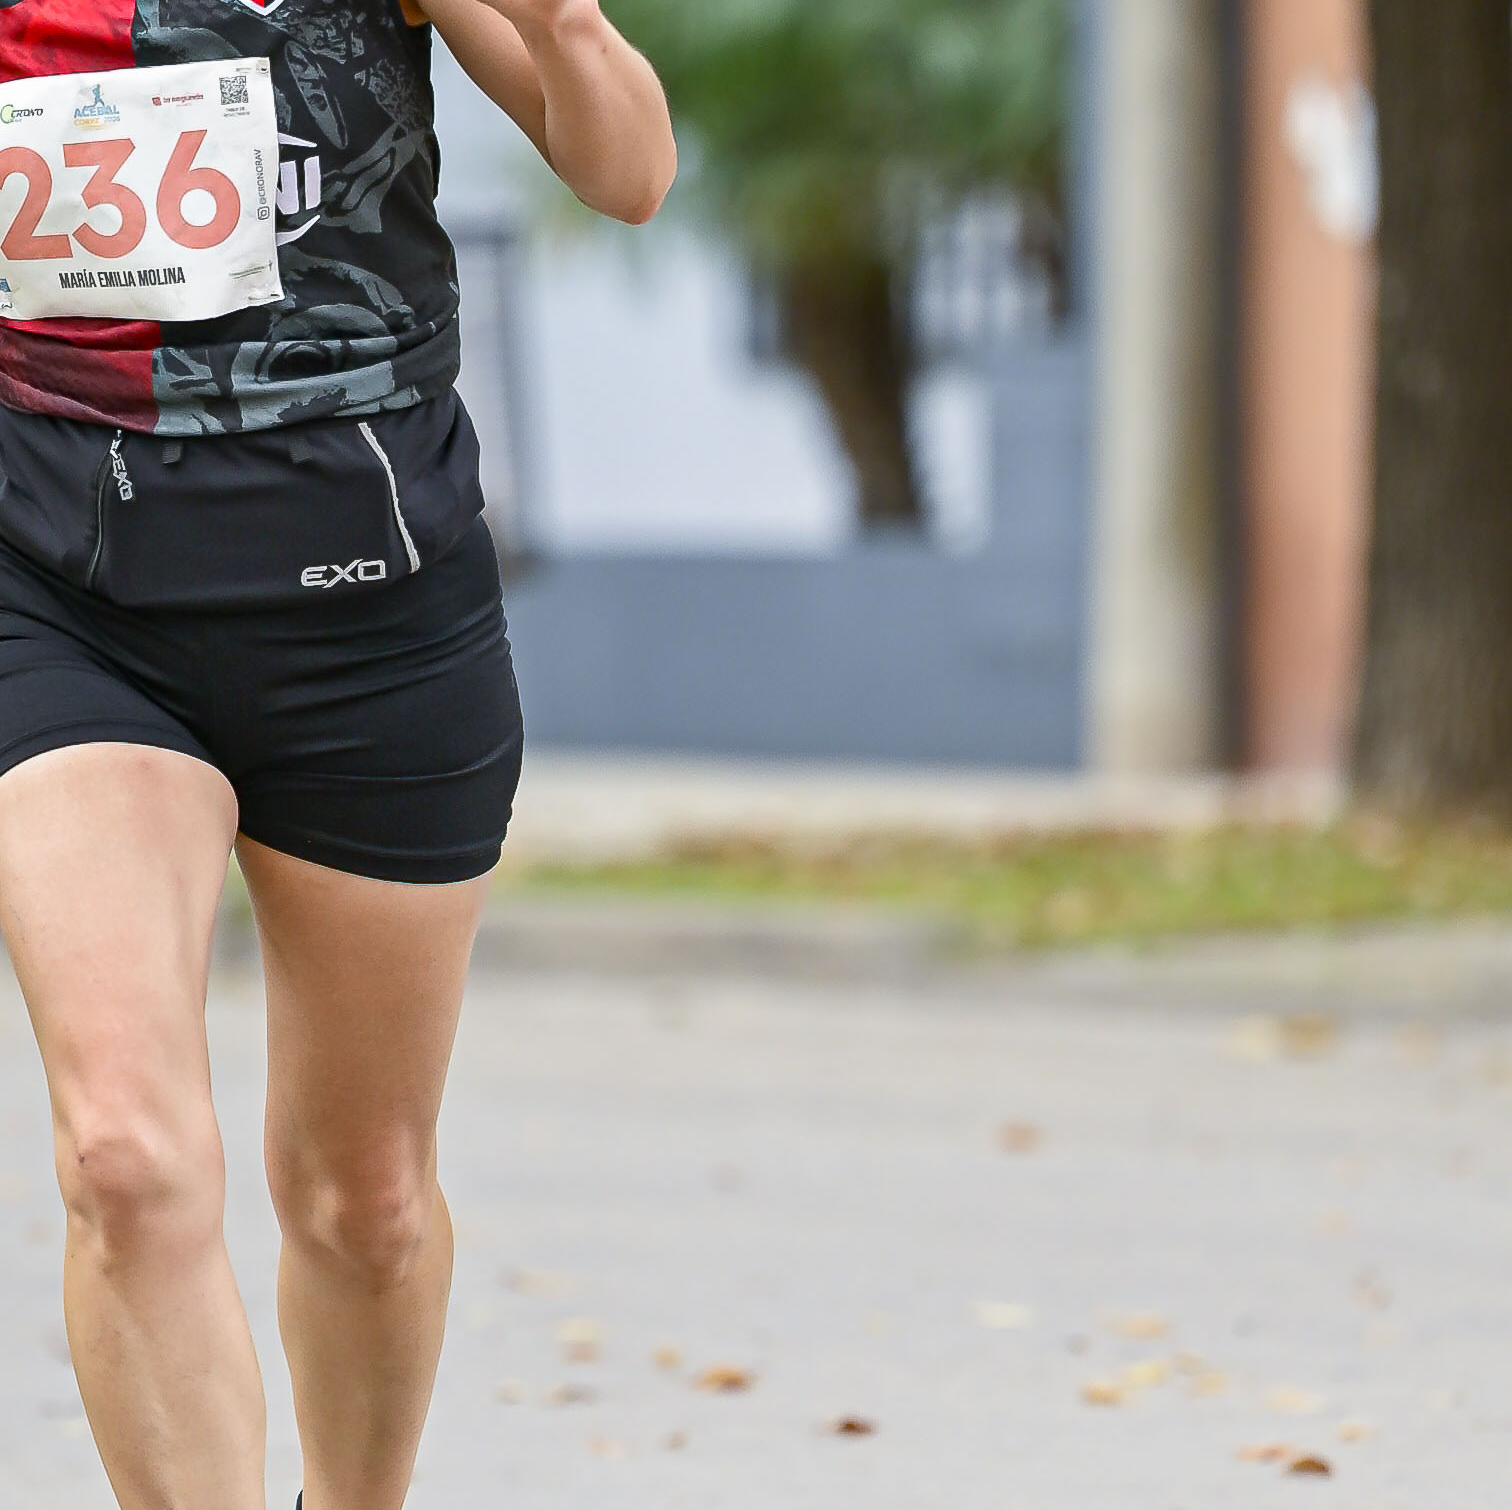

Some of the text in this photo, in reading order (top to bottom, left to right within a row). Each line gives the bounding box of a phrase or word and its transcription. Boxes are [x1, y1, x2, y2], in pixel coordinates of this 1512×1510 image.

[74, 105, 120, 118] ACEBAL
[275, 155, 322, 215] NI
[58, 266, 186, 289] MARÍA EMILIA MOLINA
[300, 558, 386, 589] EXO
